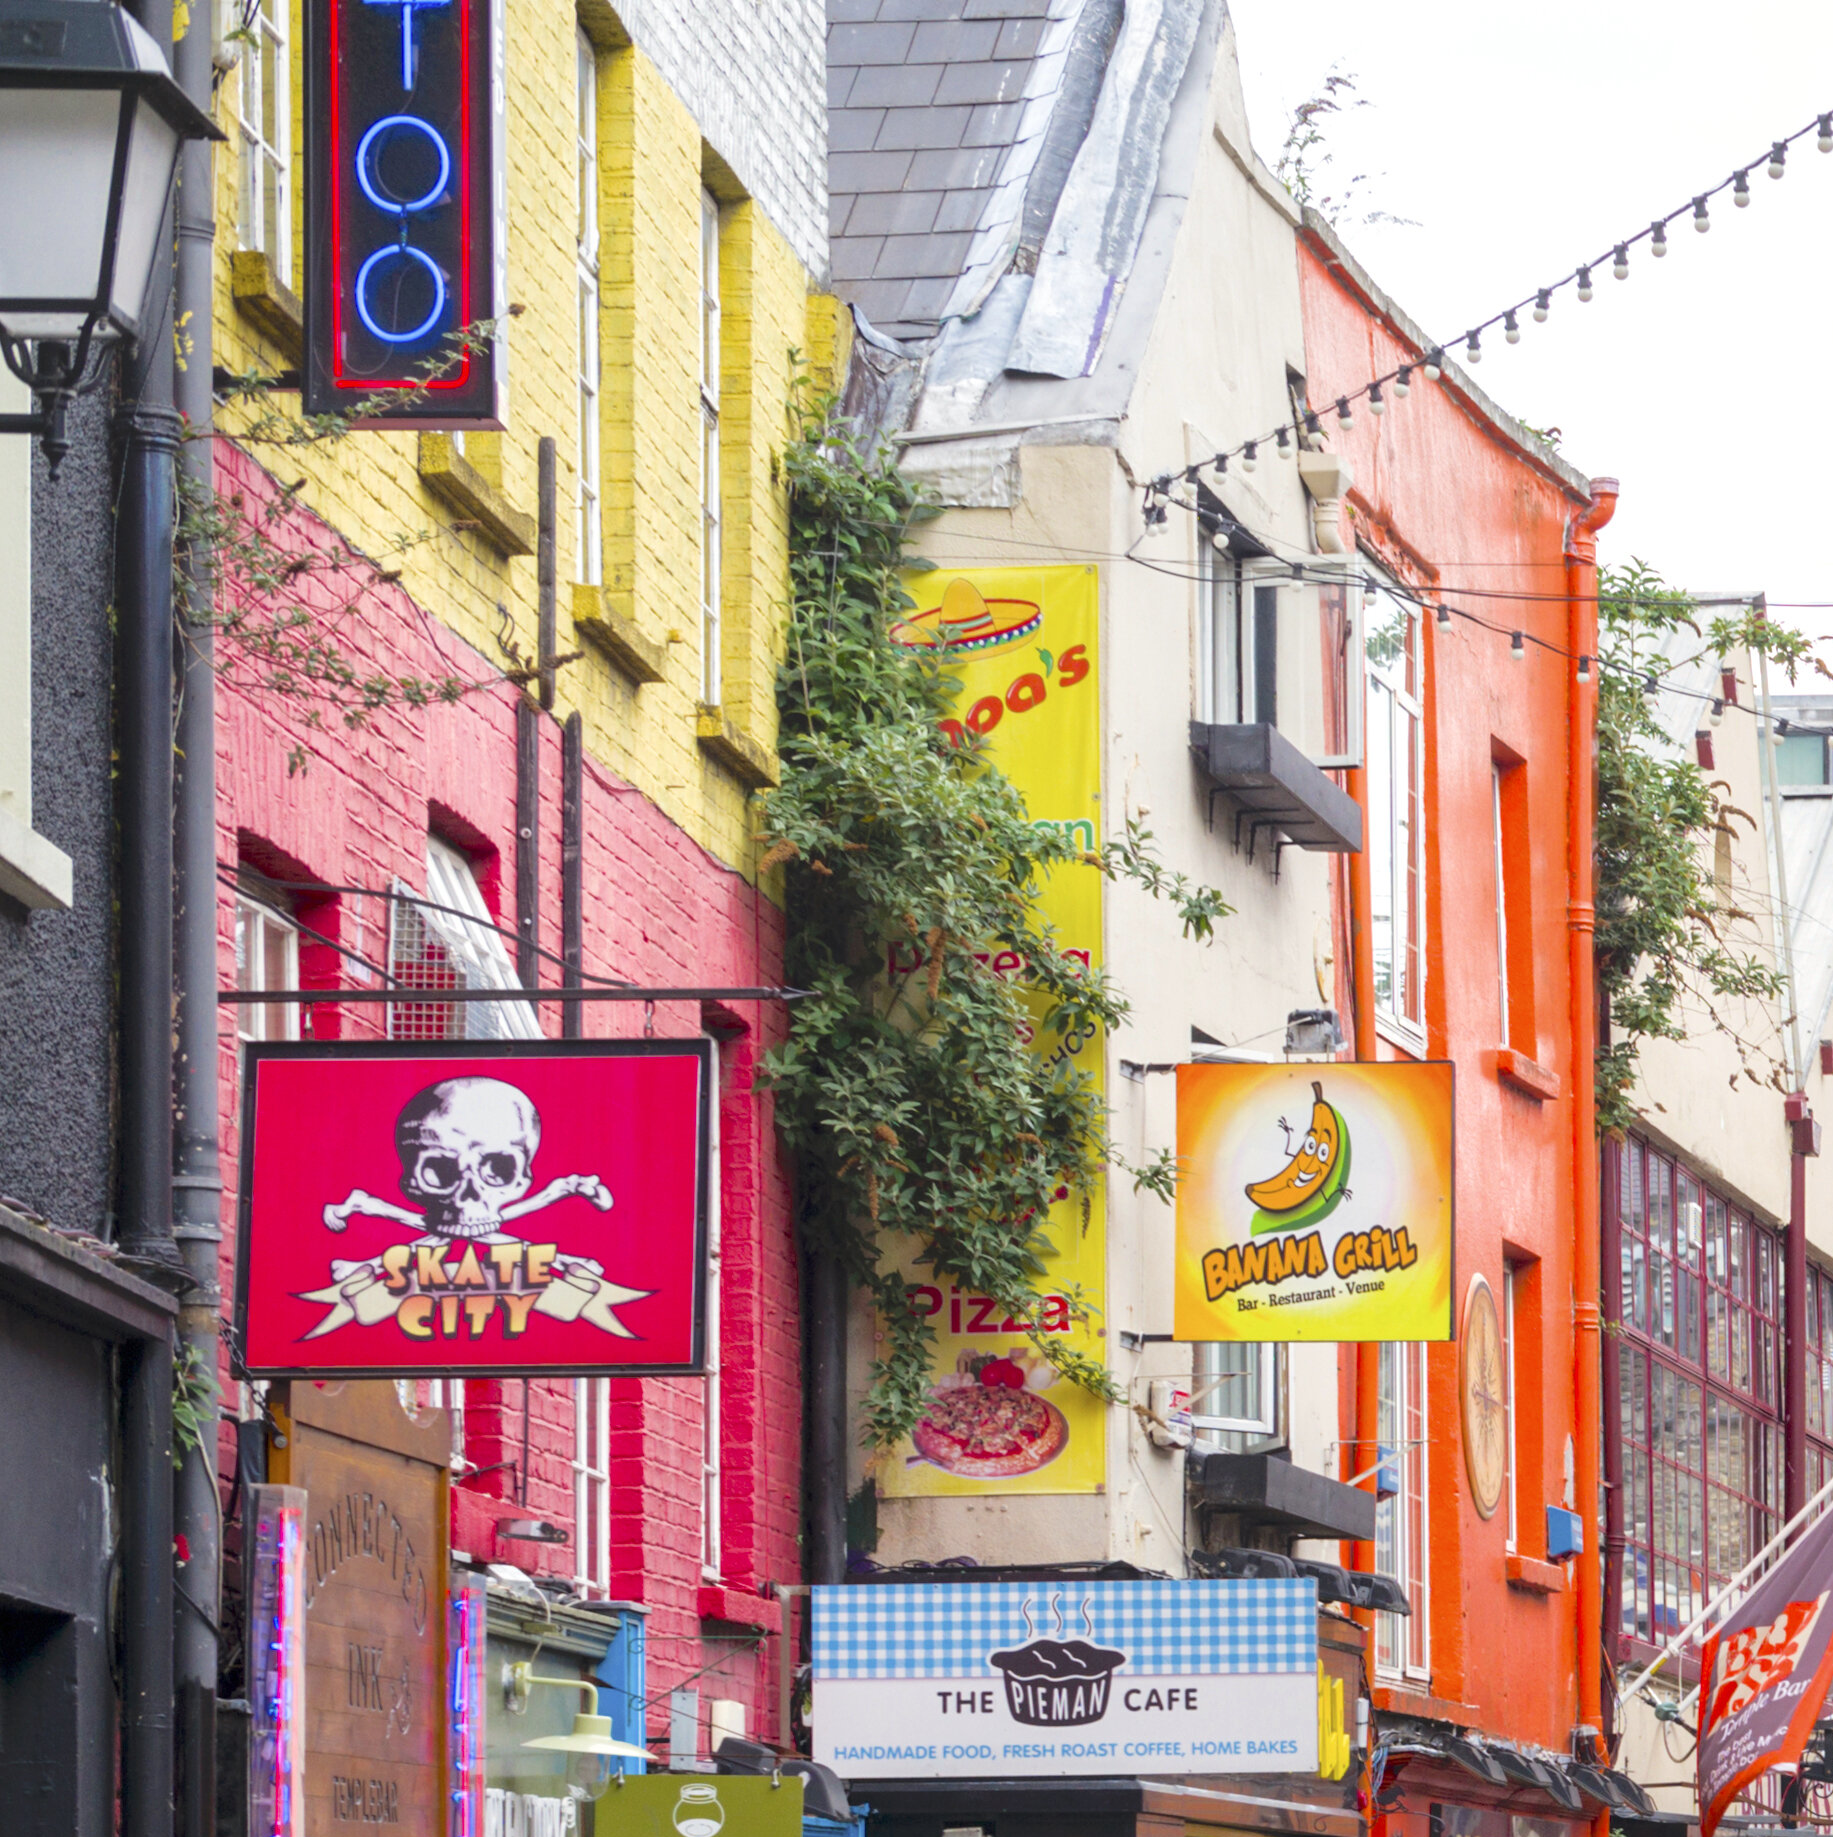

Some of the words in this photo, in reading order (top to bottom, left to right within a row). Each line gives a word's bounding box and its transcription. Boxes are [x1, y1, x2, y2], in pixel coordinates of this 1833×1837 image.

[382, 1242, 557, 1292] SKATE
[1202, 1230, 1328, 1302] BANANA
[396, 1294, 540, 1340] CITY
[1237, 1298, 1257, 1311] Bar
[1269, 1286, 1336, 1307] Restaurant
[1346, 1280, 1385, 1295] Venue
[347, 1641, 383, 1712] INK
[937, 1691, 994, 1714] THE
[1010, 1679, 1106, 1721] PIEMAN
[1124, 1688, 1198, 1711] CAFE
[834, 1745, 937, 1760] HANDMADE
[942, 1745, 998, 1761] FOOD,
[1003, 1743, 1055, 1758] FRESH
[1061, 1742, 1118, 1757] ROAST
[1123, 1741, 1186, 1759] COFFEE,
[1191, 1740, 1242, 1756] HOME
[1247, 1739, 1298, 1755] BAKES
[333, 1775, 398, 1823] TEMPLEBAR
